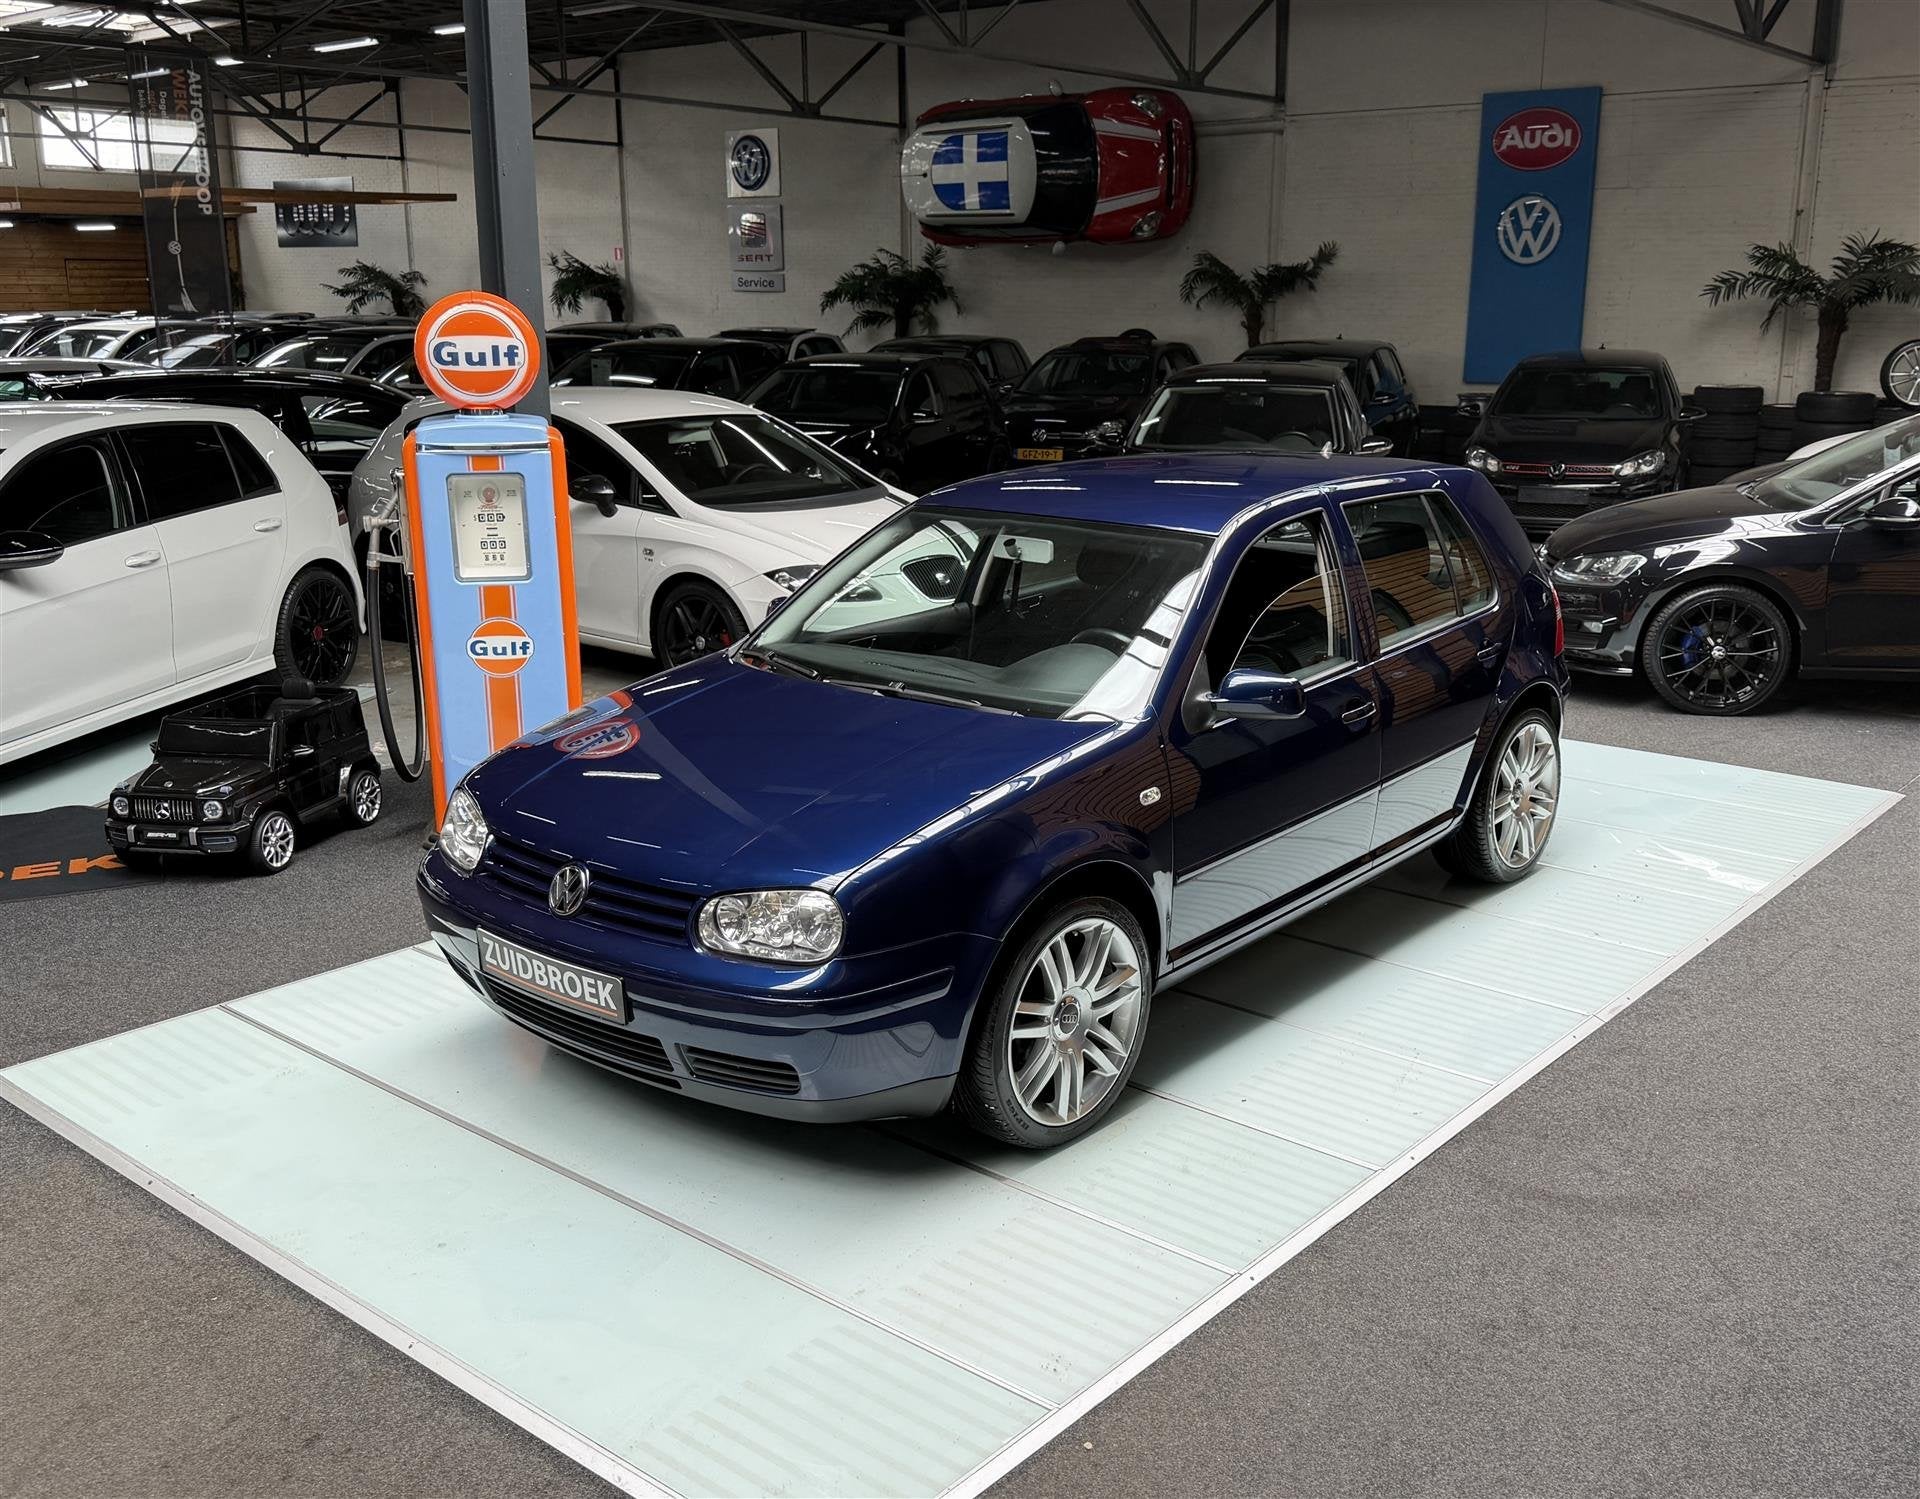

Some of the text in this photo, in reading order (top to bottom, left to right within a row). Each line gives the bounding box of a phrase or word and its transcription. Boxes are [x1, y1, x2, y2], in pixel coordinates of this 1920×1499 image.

[171, 69, 188, 120] WEKE
[737, 254, 773, 262] SEAT
[737, 276, 775, 288] Service
[433, 341, 519, 366] Gulf
[470, 640, 530, 656] Gulf
[0, 854, 127, 881] EK
[483, 937, 616, 1010] ZUIDBROEK
